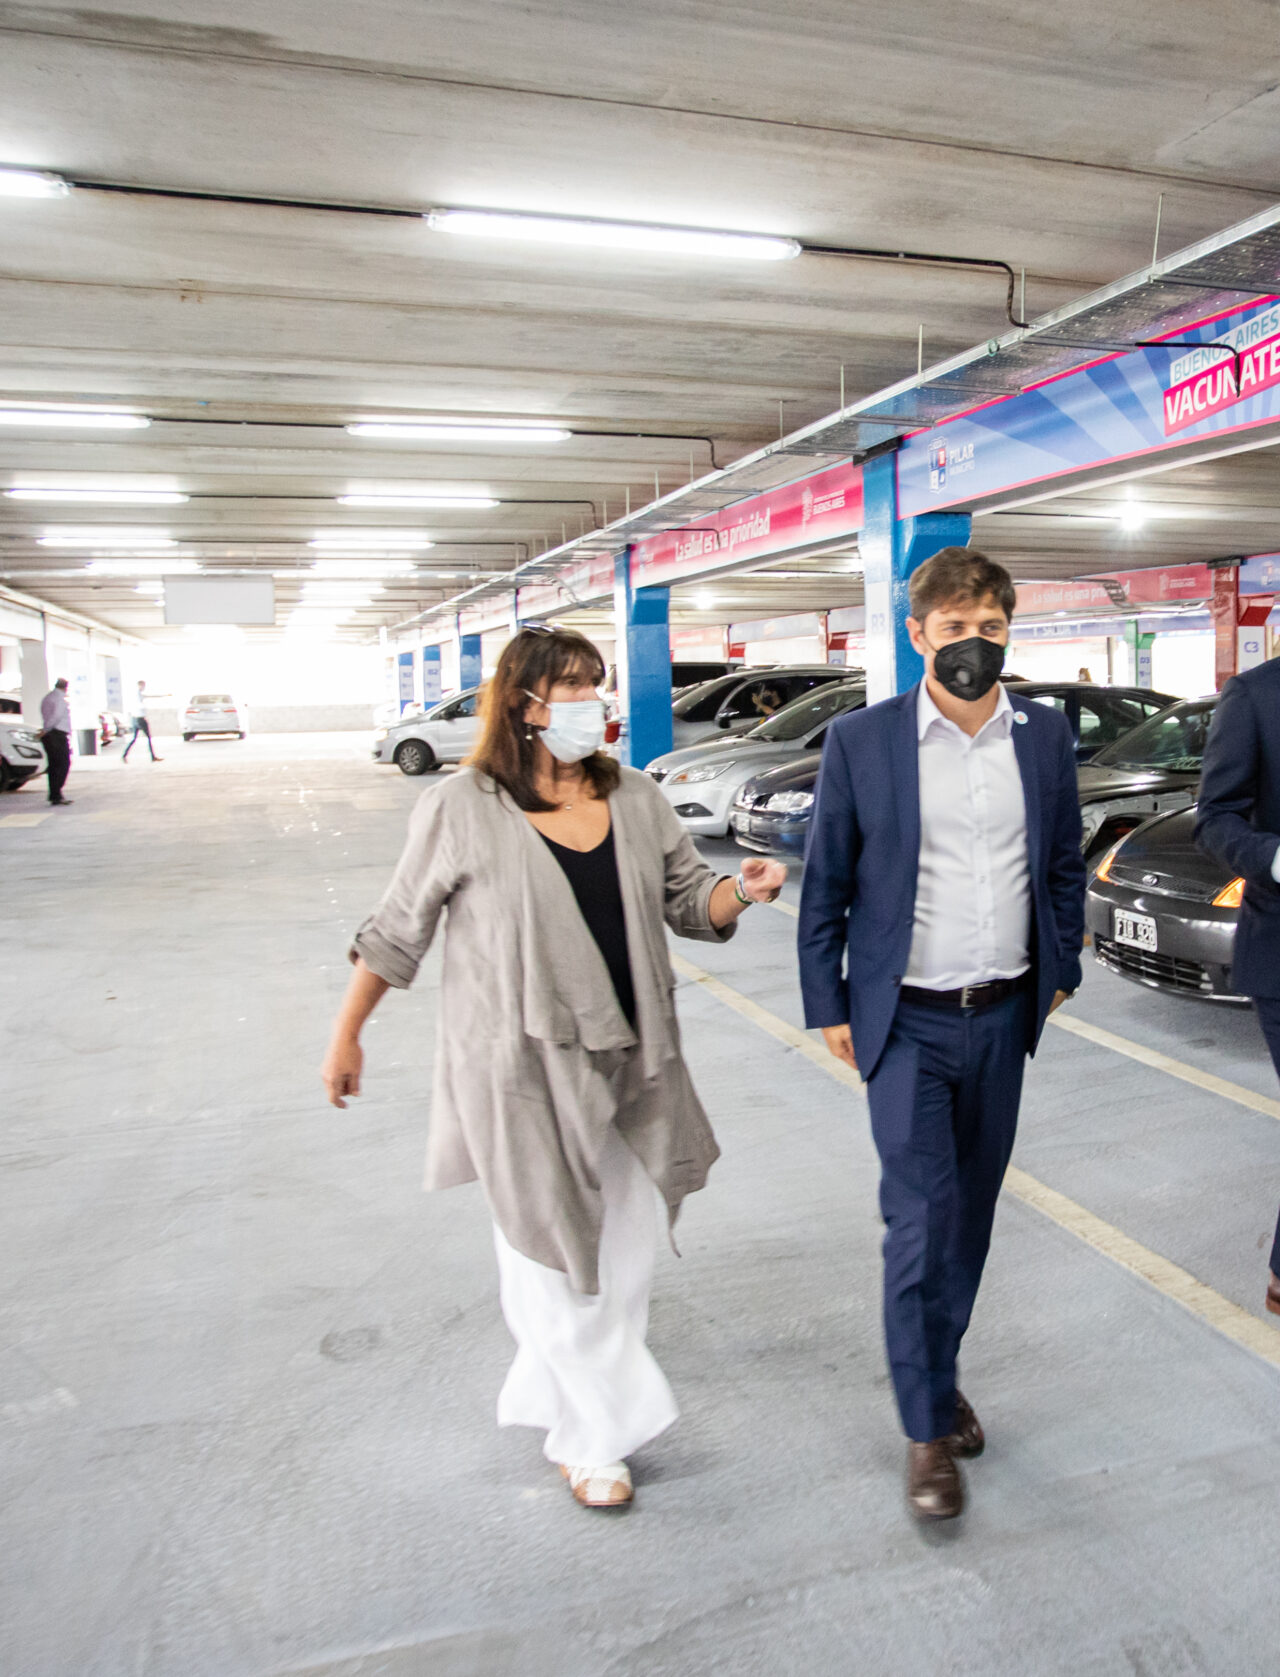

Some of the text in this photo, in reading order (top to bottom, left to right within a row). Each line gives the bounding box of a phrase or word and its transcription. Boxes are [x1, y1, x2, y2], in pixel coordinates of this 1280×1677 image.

[1174, 309, 1279, 382] BUENOS AIRES
[949, 443, 975, 464] PILAR
[729, 507, 771, 553] prioridad
